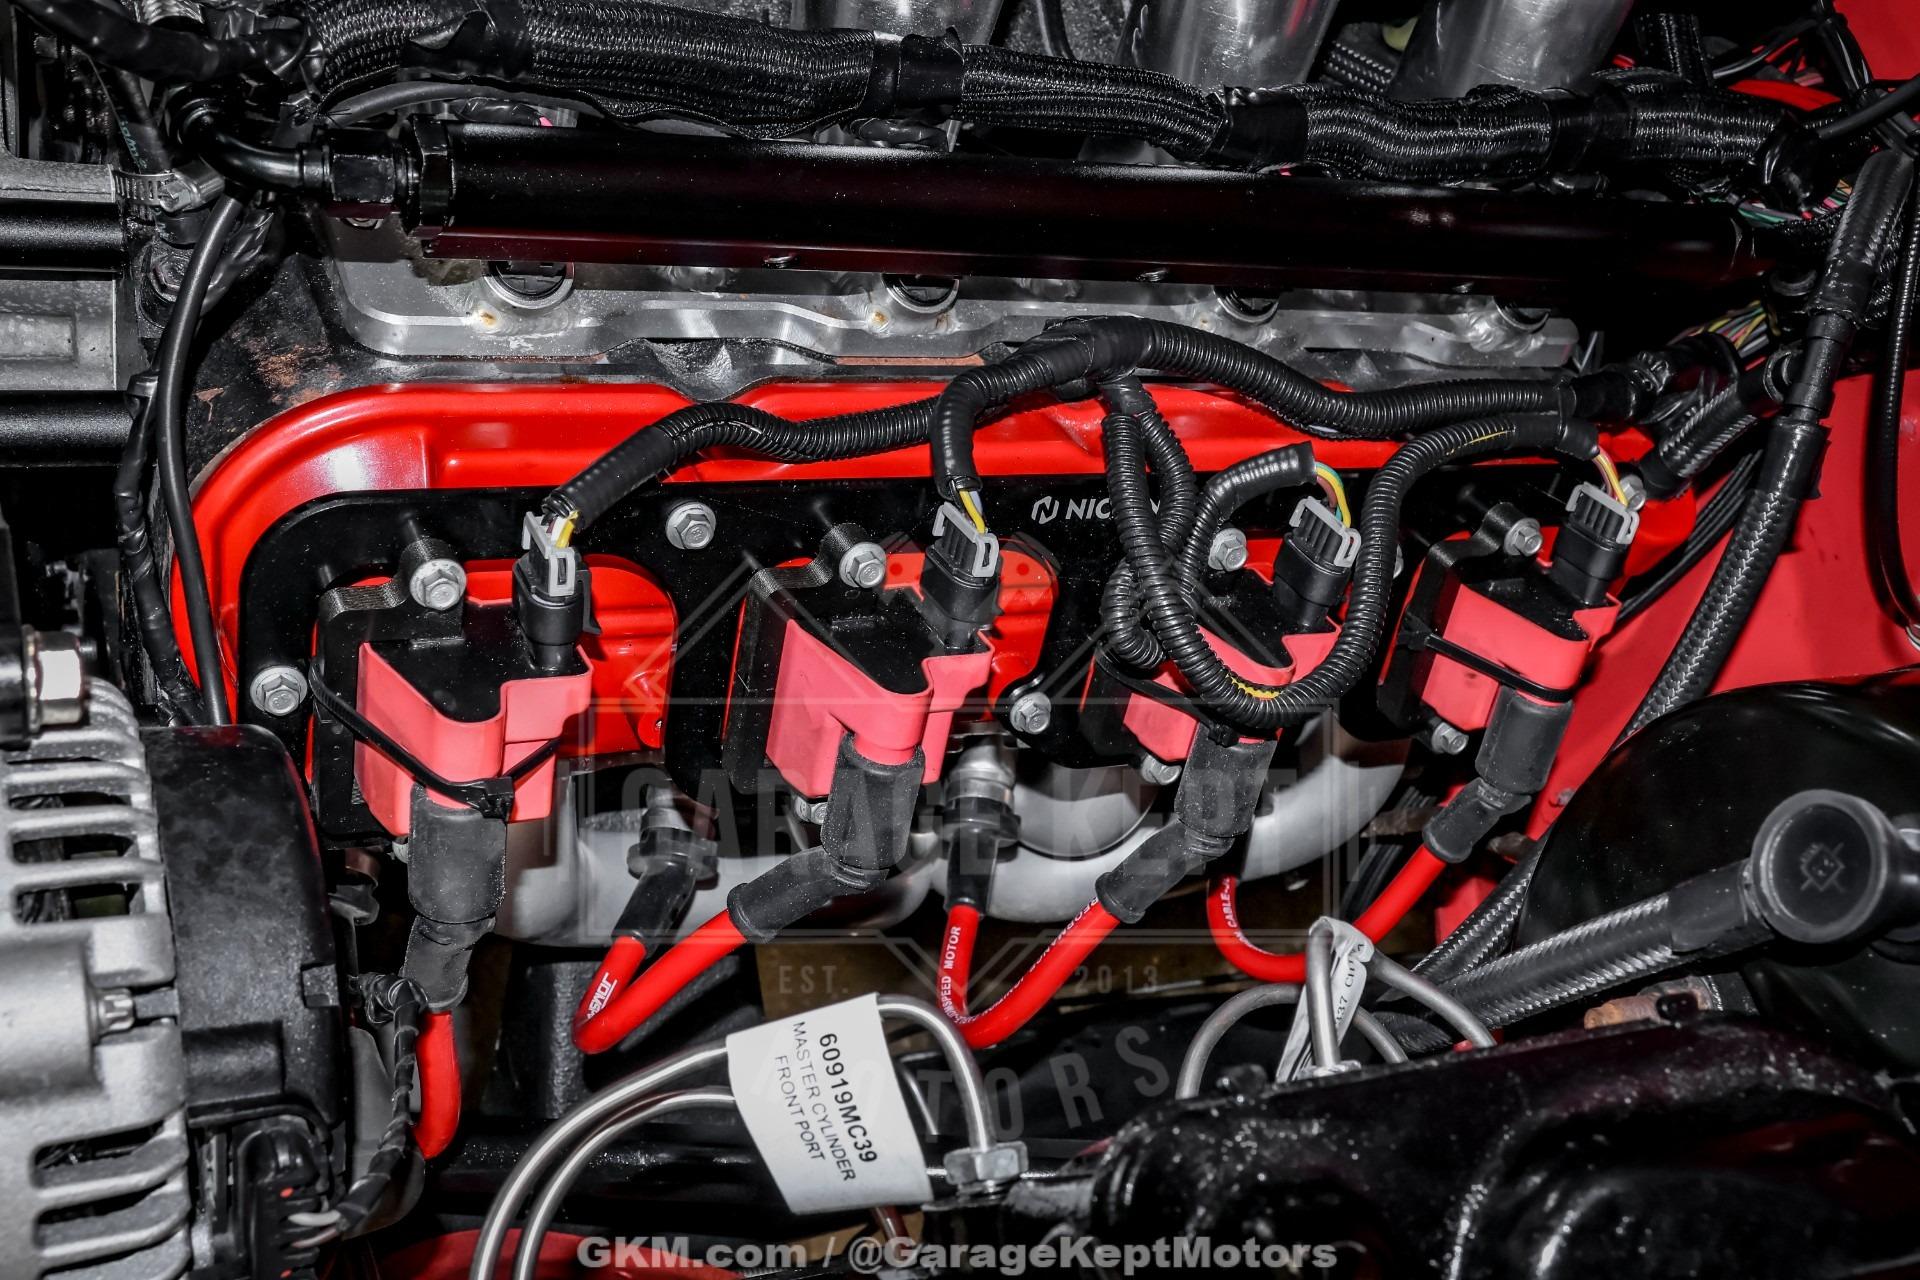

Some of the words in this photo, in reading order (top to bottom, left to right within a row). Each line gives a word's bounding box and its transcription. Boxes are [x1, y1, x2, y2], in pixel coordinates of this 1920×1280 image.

[943, 925, 961, 970] MOTOR
[775, 1055, 805, 1116] FRONT
[795, 1121, 826, 1161] PORT
[793, 1021, 821, 1100] MASTER
[811, 1103, 857, 1181] CYLINDER
[819, 1033, 878, 1163] 60919MC39
